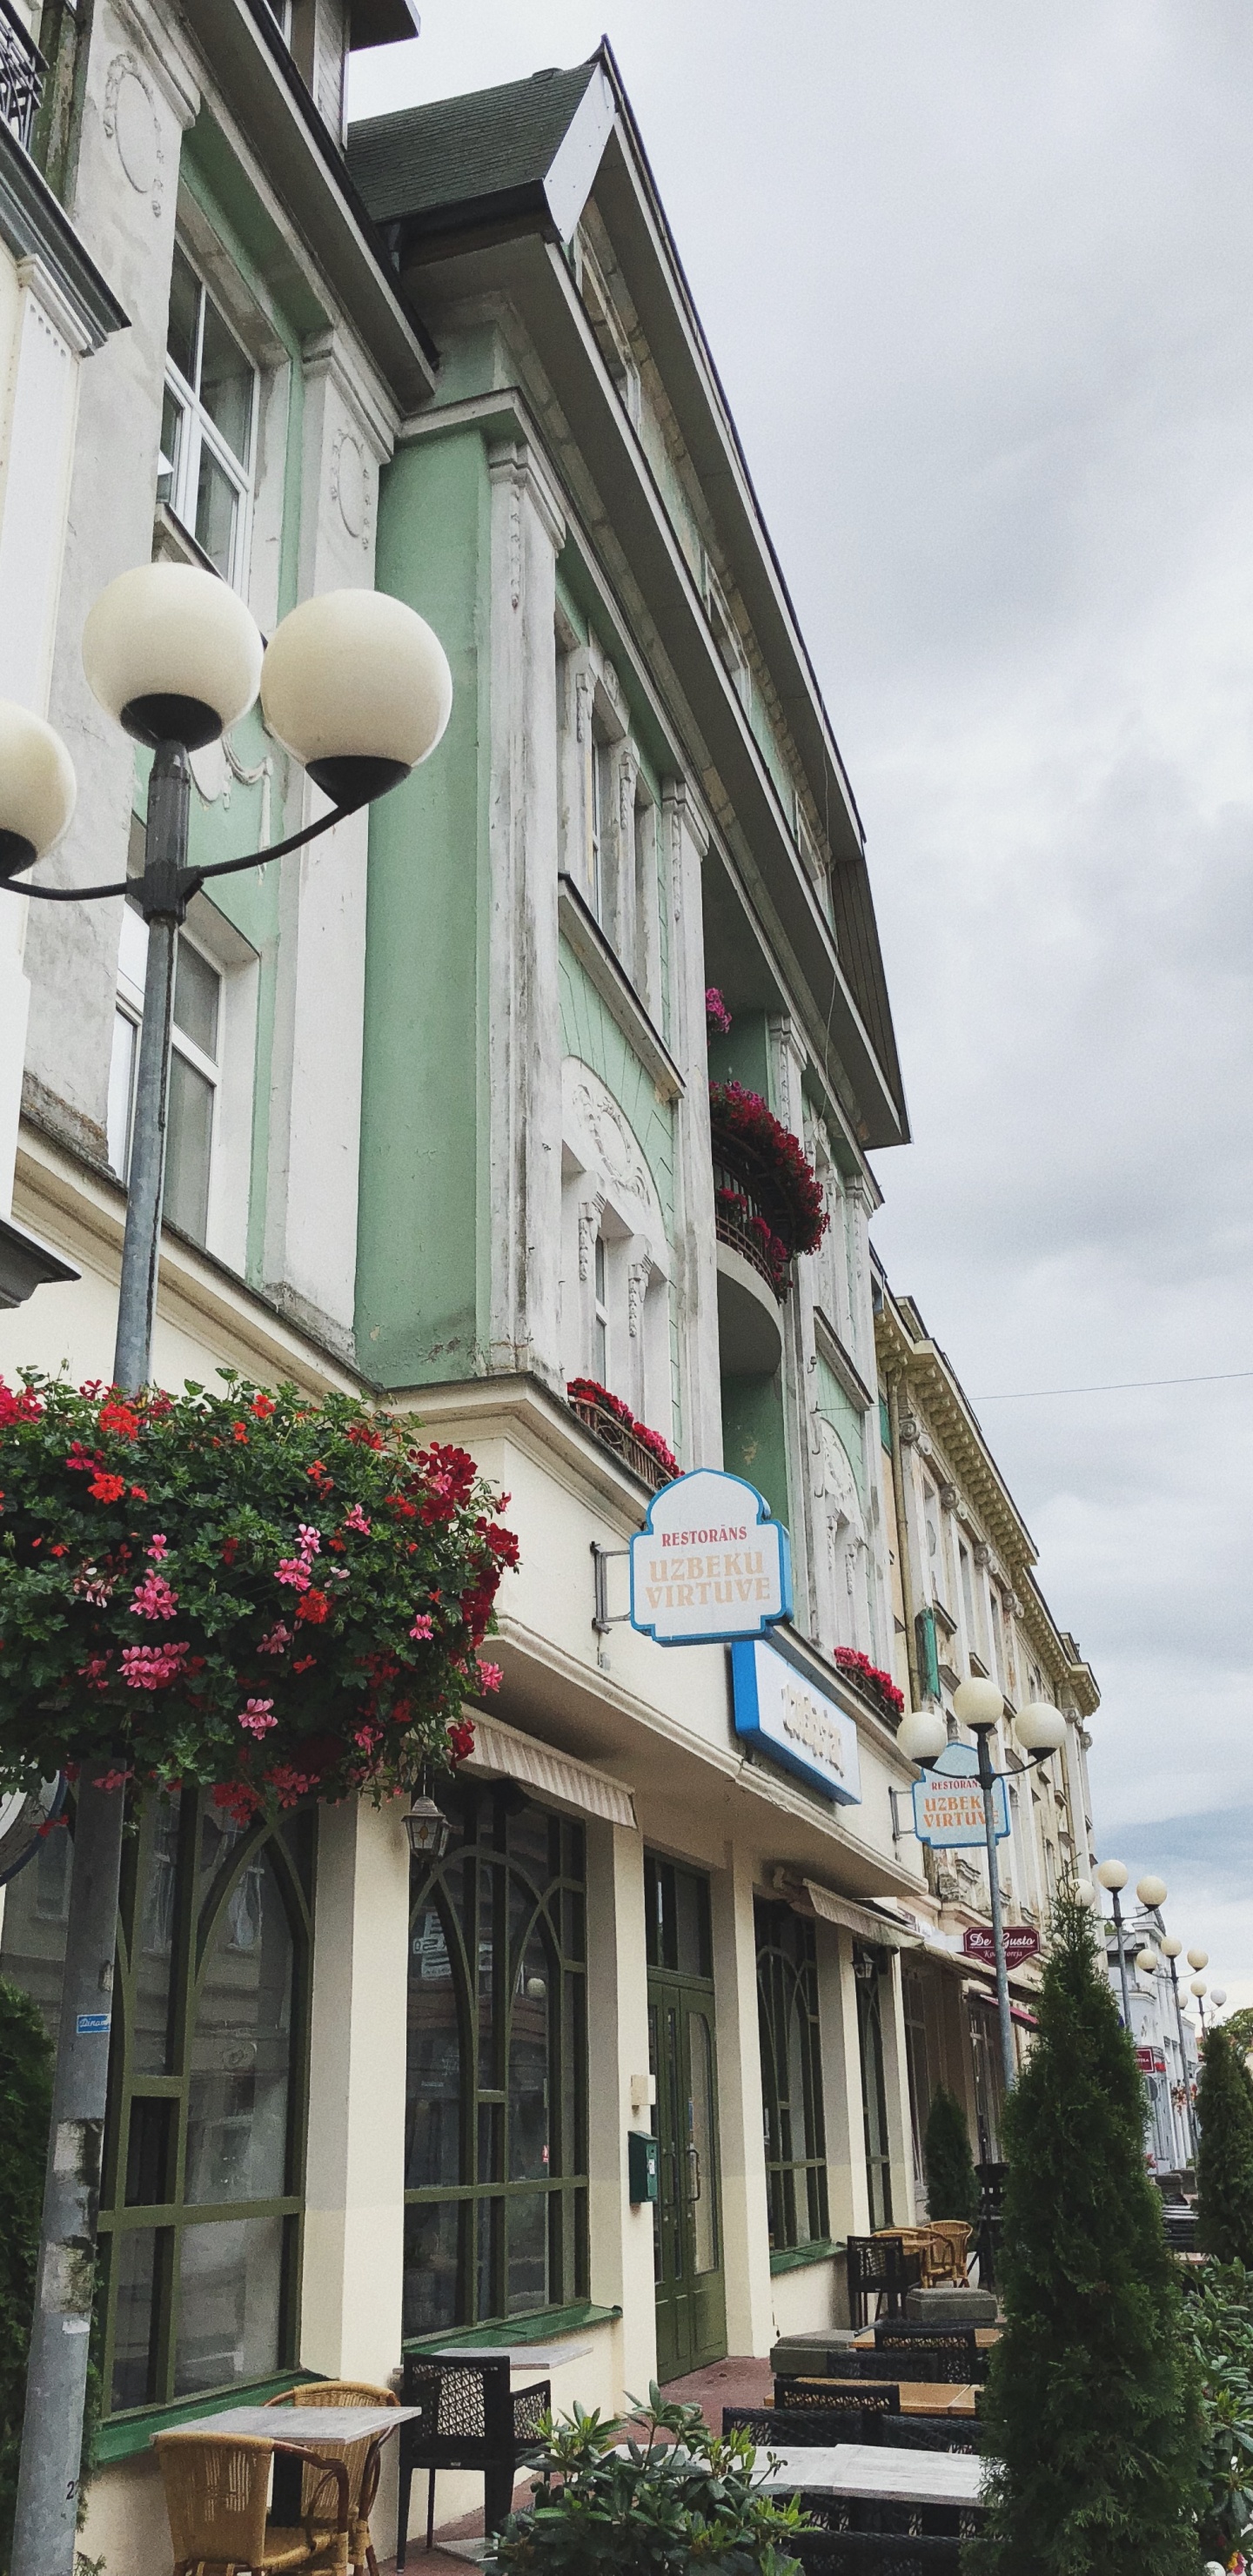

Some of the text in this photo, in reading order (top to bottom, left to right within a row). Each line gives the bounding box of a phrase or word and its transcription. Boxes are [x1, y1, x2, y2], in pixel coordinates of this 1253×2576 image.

[661, 1524, 747, 1546] RESTORĀNS
[649, 1551, 765, 1582] UZBEKU
[645, 1577, 771, 1609] VIRTUVE
[924, 1795, 993, 1812] UZBEK
[969, 1932, 1035, 1949] De Gusto
